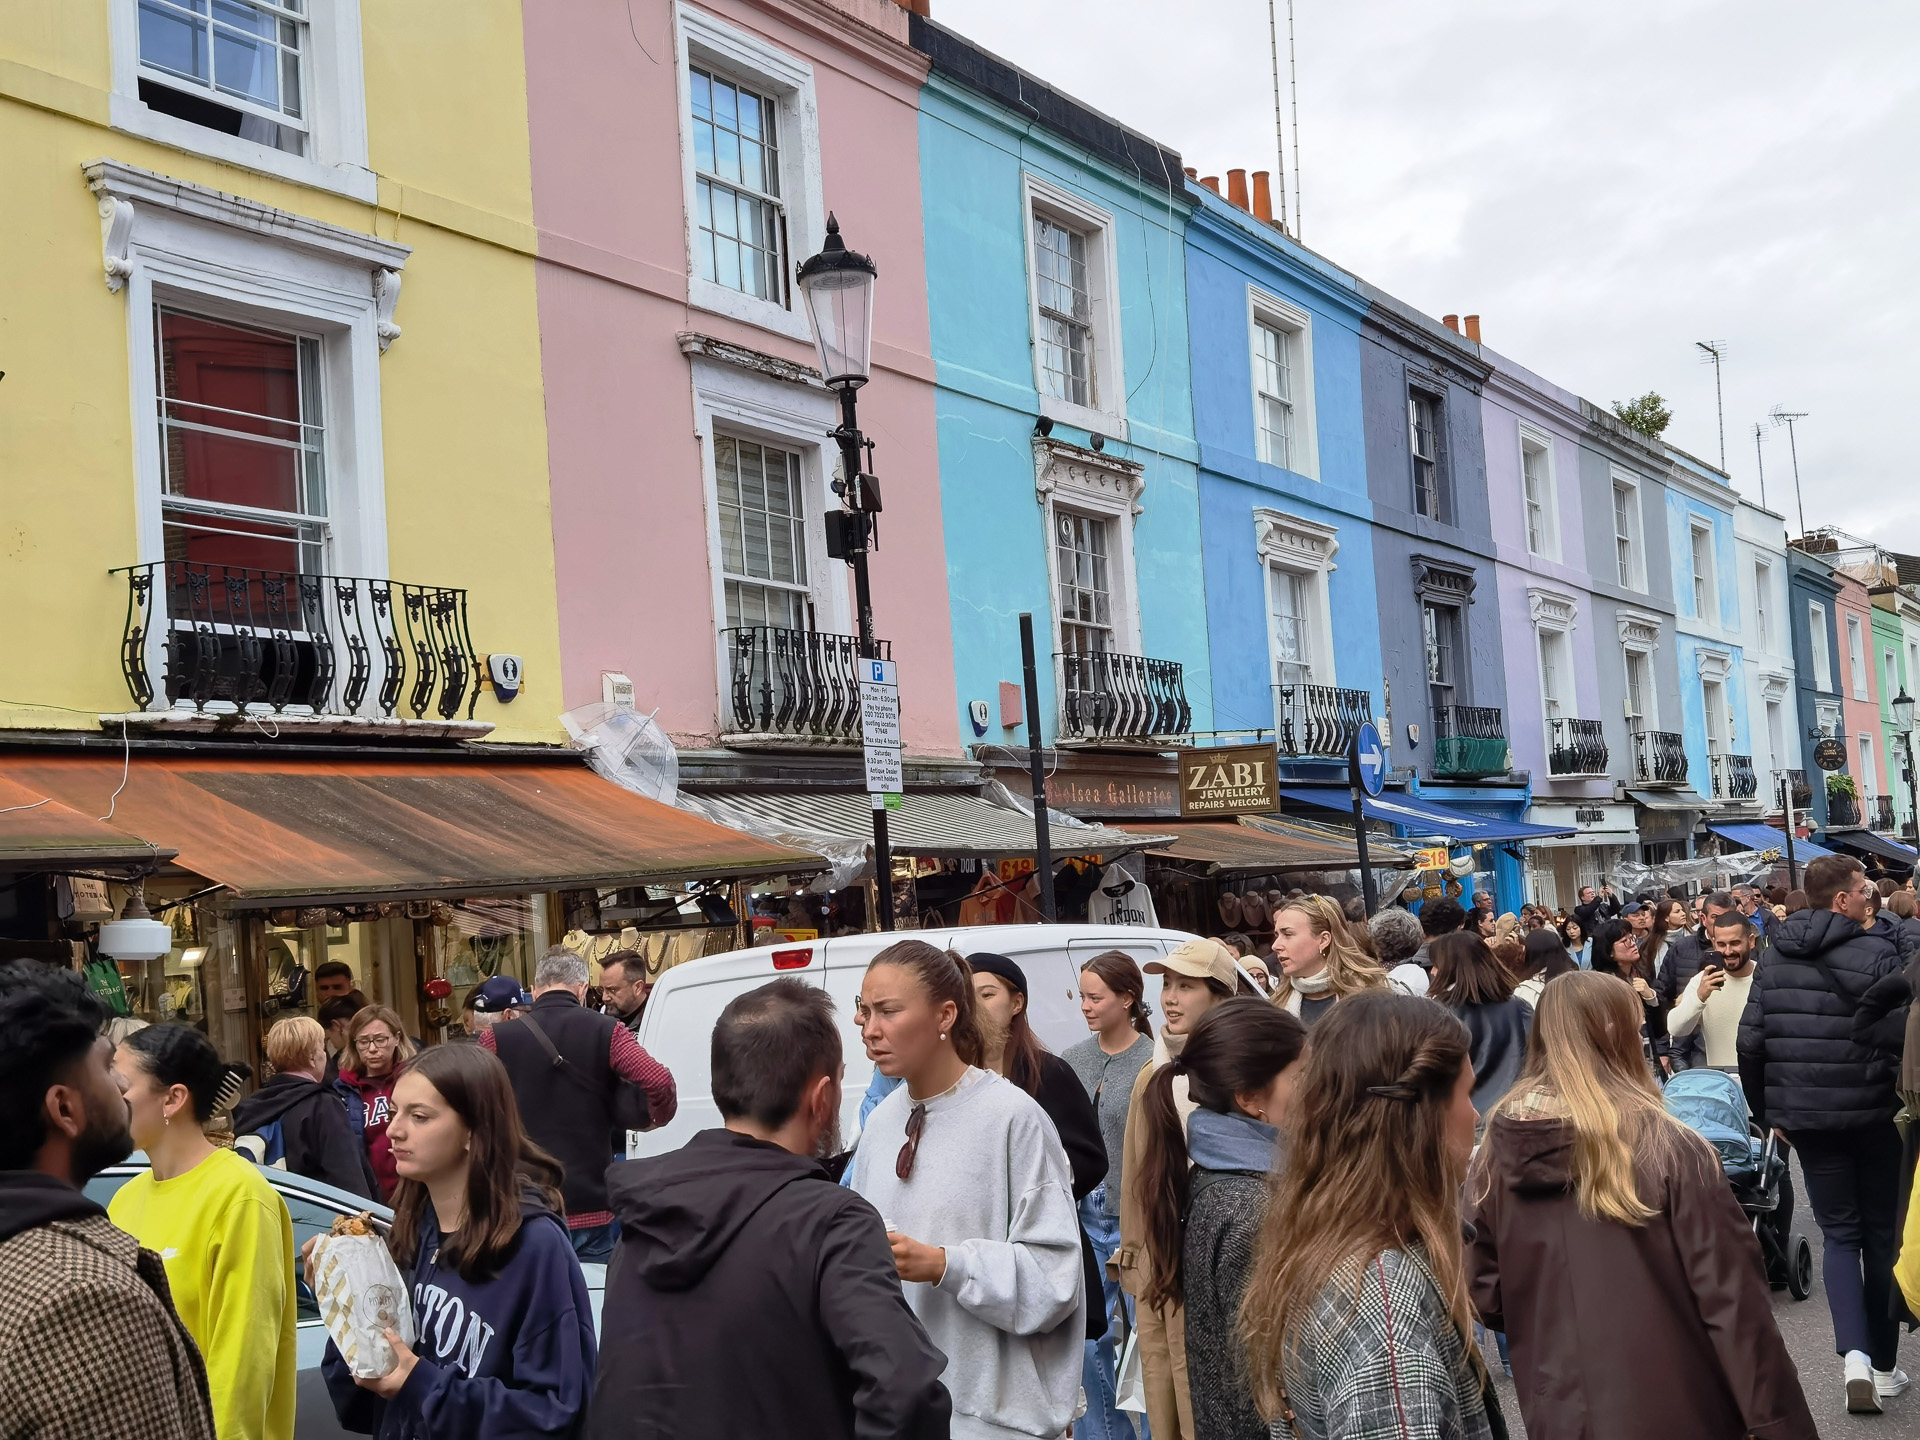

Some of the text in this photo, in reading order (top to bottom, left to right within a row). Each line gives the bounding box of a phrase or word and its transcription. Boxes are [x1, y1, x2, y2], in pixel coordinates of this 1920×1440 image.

[874, 664, 882, 680] P
[1188, 762, 1266, 790] ZABI
[1200, 786, 1266, 800] JEWELLERY
[1189, 798, 1270, 810] REPAIRS WELCOME
